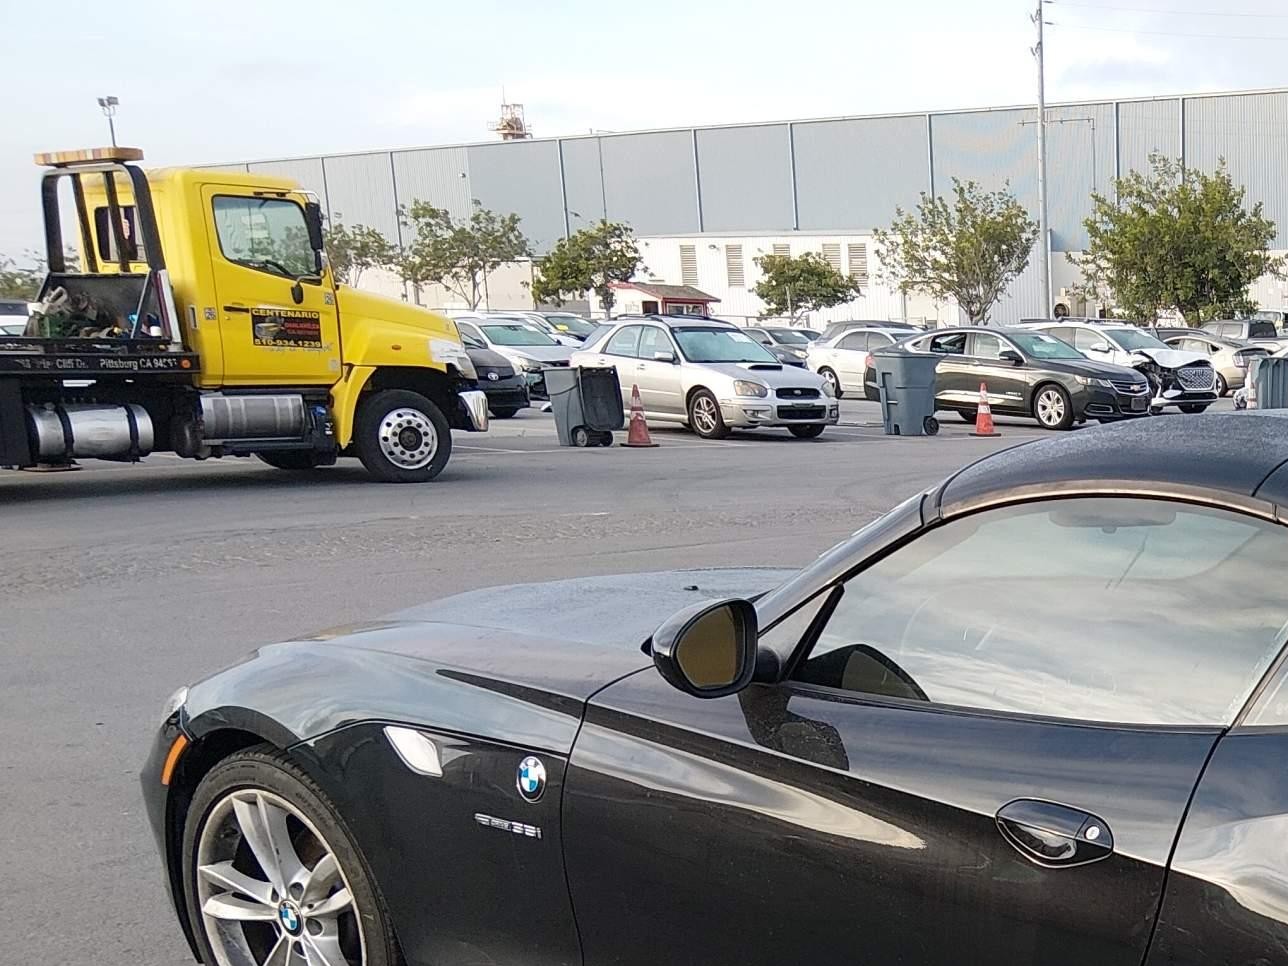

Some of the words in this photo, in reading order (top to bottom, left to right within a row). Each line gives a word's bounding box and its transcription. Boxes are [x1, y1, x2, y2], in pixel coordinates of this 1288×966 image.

[253, 309, 319, 319] CENTENARIO
[99, 358, 138, 370] Pittsburg
[139, 358, 153, 368] CA
